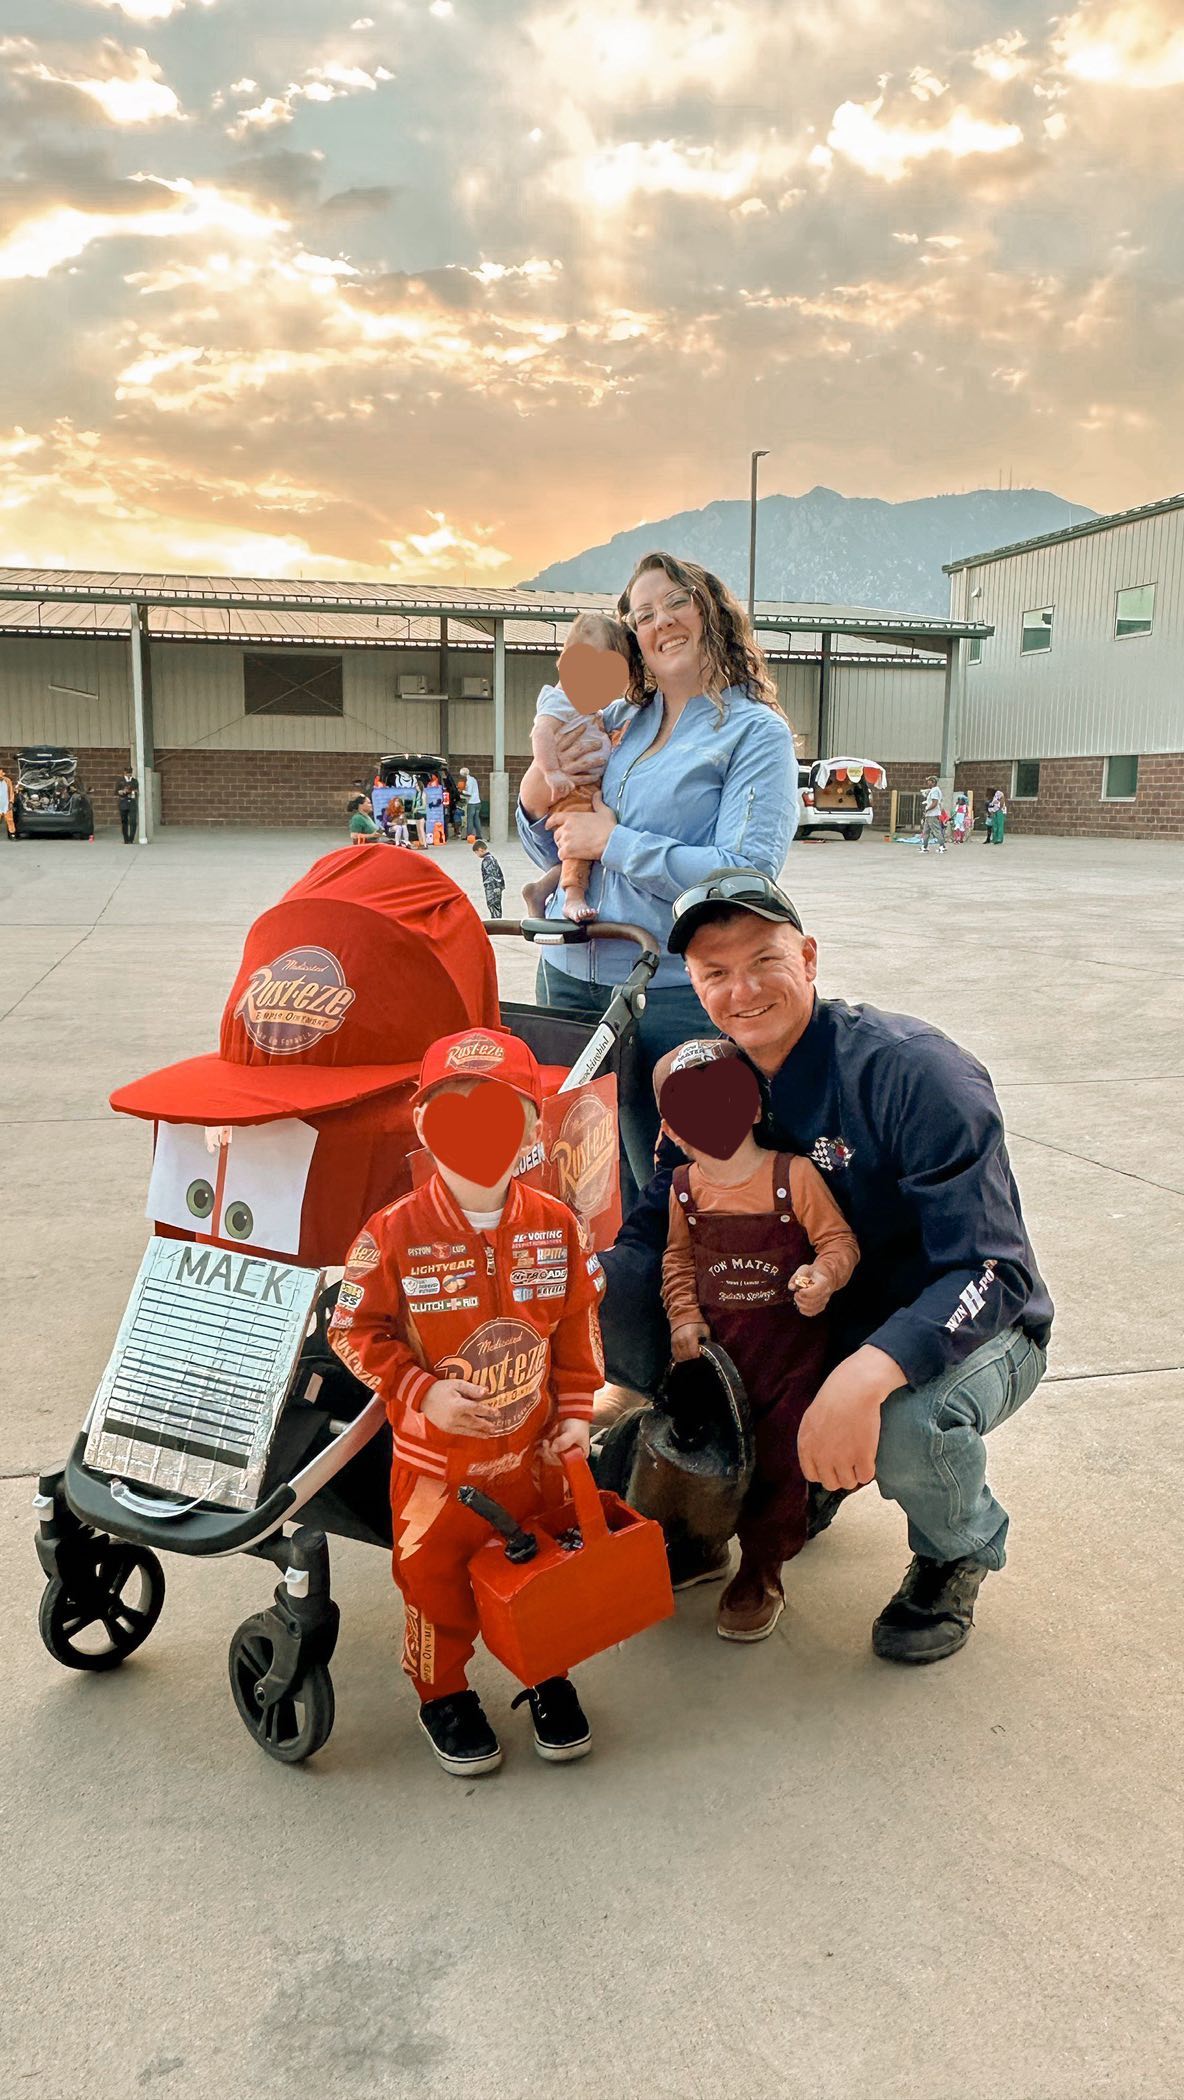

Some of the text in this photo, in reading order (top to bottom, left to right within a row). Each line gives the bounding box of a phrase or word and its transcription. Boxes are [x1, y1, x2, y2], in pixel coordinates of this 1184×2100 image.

[175, 1246, 294, 1305] MACK
[410, 1259, 475, 1275] LIGHTYEAR
[708, 1258, 779, 1277] TOW MATER
